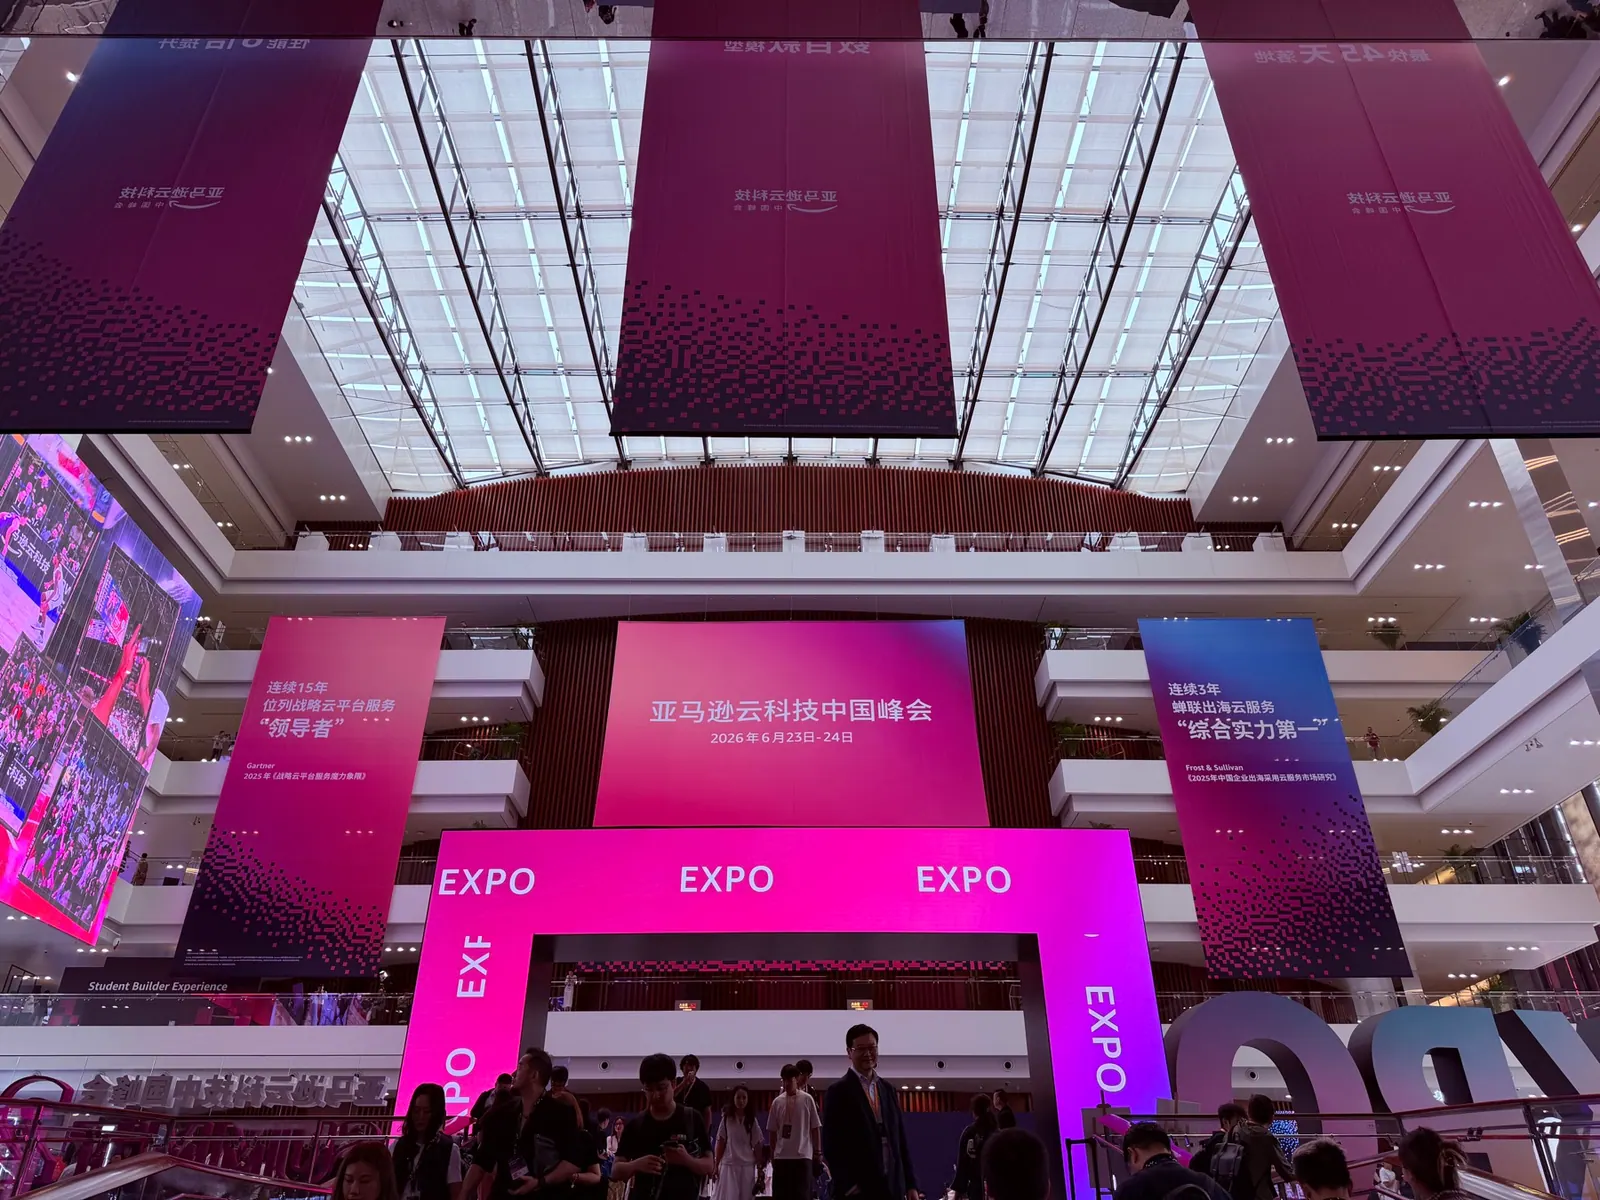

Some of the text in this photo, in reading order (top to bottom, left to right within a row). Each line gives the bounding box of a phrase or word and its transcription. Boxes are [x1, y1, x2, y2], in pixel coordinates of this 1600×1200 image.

[266, 681, 329, 695] 连续15年
[1168, 682, 1222, 696] 连续3年
[262, 699, 396, 713] 位列战略云平台服务
[649, 698, 932, 723] 亚马逊云科技中国峰会
[1172, 700, 1275, 714] 蝉联出海云服务
[259, 718, 345, 739] “领导者”
[1177, 718, 1327, 740] “综合实力第一”
[438, 867, 536, 895] EXPO
[680, 865, 774, 893] EXPO
[916, 866, 1012, 893] EXPO
[87, 981, 228, 993] Student Builder Experience
[1085, 986, 1127, 1092] EXPO
